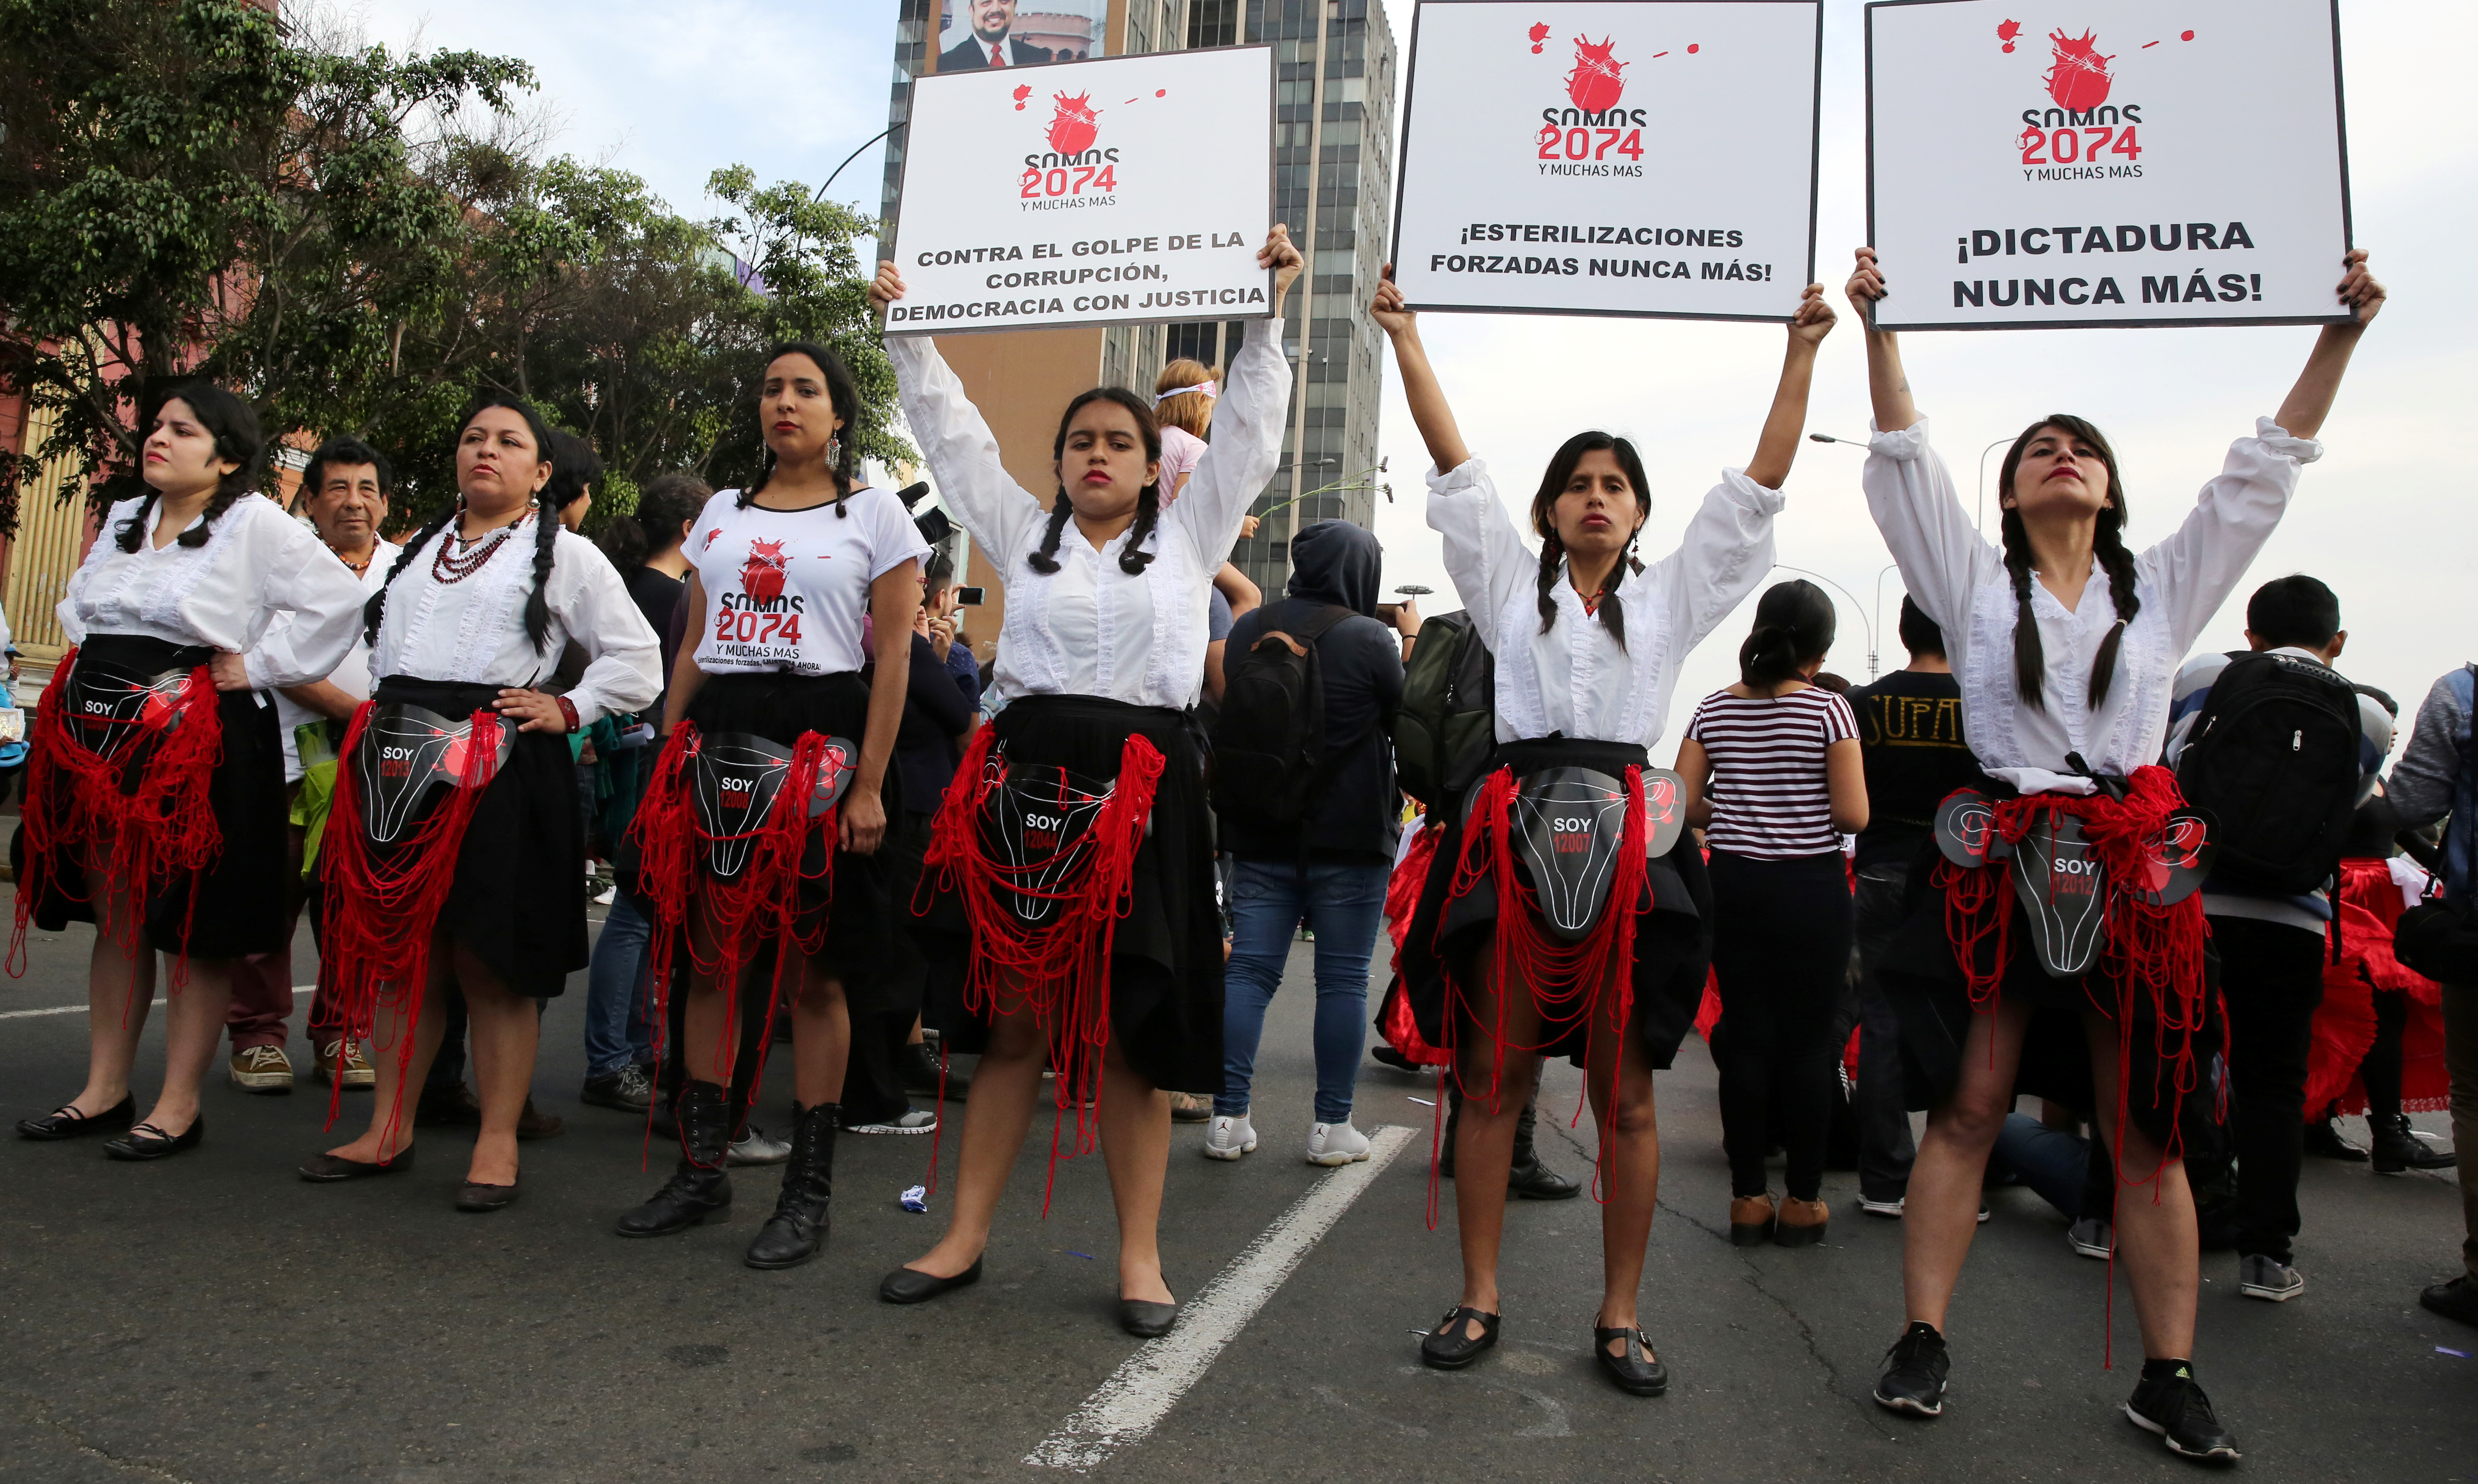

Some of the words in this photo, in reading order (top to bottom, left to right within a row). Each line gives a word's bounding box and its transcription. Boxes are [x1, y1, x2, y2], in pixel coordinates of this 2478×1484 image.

[1543, 108, 1647, 127] SOMOS
[2022, 105, 2142, 128] SOMOS
[1538, 127, 1644, 160] 2074
[2021, 127, 2142, 164] 2074
[1025, 148, 1119, 169] SOMOS
[1539, 164, 1547, 175] Y
[1551, 164, 1609, 177] MUCHAS
[1613, 165, 1642, 177] MAS
[2024, 169, 2033, 182] Y
[2039, 166, 2104, 181] MUCHAS
[2110, 165, 2142, 178] MAS
[1021, 165, 1117, 198] 2074
[1021, 202, 1028, 211] Y
[1033, 198, 1085, 210] MUCHAS
[1090, 196, 1115, 207] MAS
[1461, 224, 1743, 248] ¡ESTERILIZACIONES
[1958, 222, 2255, 264] ¡DICTADURA
[918, 246, 1023, 267] CONTRA
[1032, 243, 1063, 259] EL
[1072, 237, 1158, 256] GOLPE
[1168, 234, 1202, 250] DE
[1212, 232, 1244, 248] LA
[986, 262, 1168, 289] CORRUPCIÓN,
[1431, 254, 1578, 276] FORZADAS
[1589, 259, 1691, 279] NUNCA
[1701, 259, 1771, 281] MÁS!
[1954, 277, 2125, 308] NUNCA
[2141, 268, 2262, 303] MÁS!
[891, 298, 1064, 321] DEMOCRACIA
[1073, 294, 1129, 311] CON
[1138, 287, 1265, 308] JUSTICIA
[721, 592, 804, 614] SOMOS
[717, 610, 801, 645] 2074
[717, 644, 723, 655] Y
[726, 645, 770, 657] MUCHAS
[774, 648, 799, 659] MAS
[736, 658, 762, 667] forzadas,
[85, 701, 113, 715] SOY
[383, 747, 414, 761] SOY
[381, 760, 410, 778] 12013
[722, 778, 753, 792] SOY
[719, 789, 750, 809] 12008
[1026, 814, 1061, 831] SOY
[1553, 818, 1592, 832] SOY
[1024, 829, 1058, 850] 12044
[1554, 833, 1591, 853] 12007
[2054, 858, 2095, 875] SOY
[2054, 873, 2094, 895] 12012
